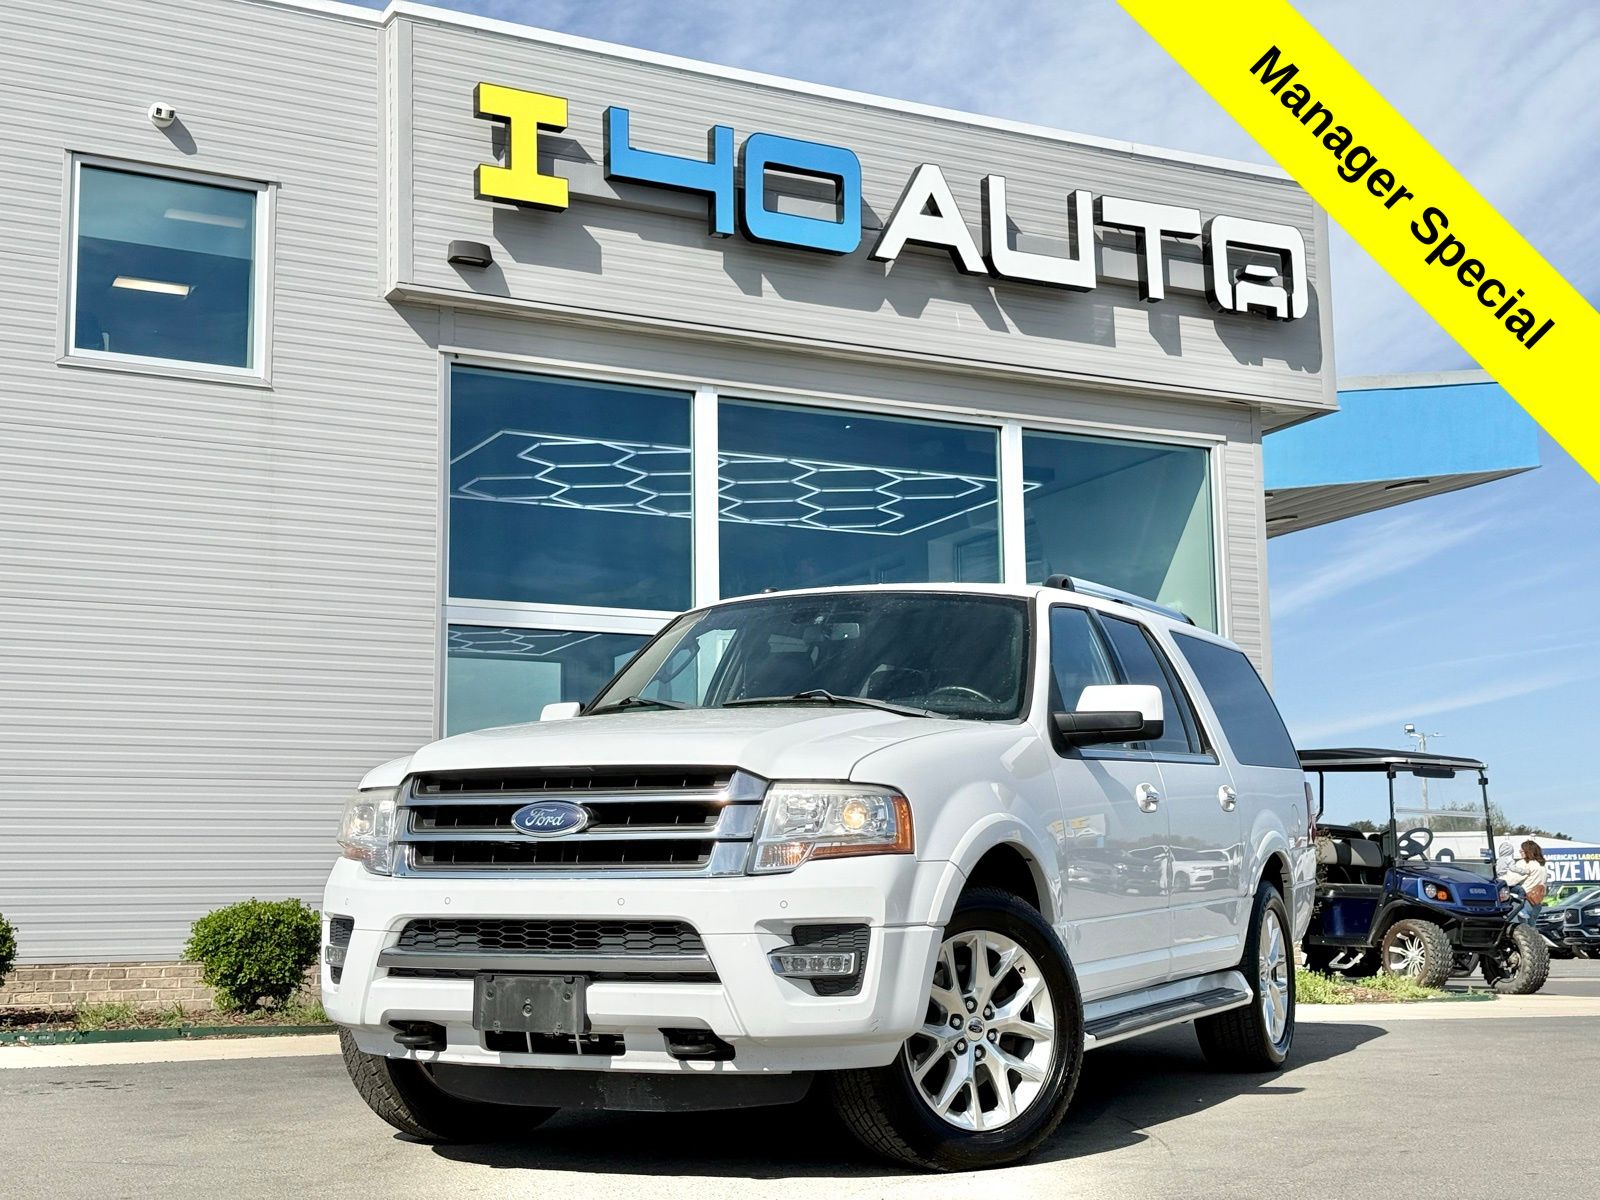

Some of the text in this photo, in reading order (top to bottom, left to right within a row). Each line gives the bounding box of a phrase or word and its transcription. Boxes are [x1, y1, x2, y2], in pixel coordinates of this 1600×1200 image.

[868, 163, 1308, 321] AUTO
[525, 807, 566, 827] Ford
[1545, 860, 1600, 882] SIZE M
